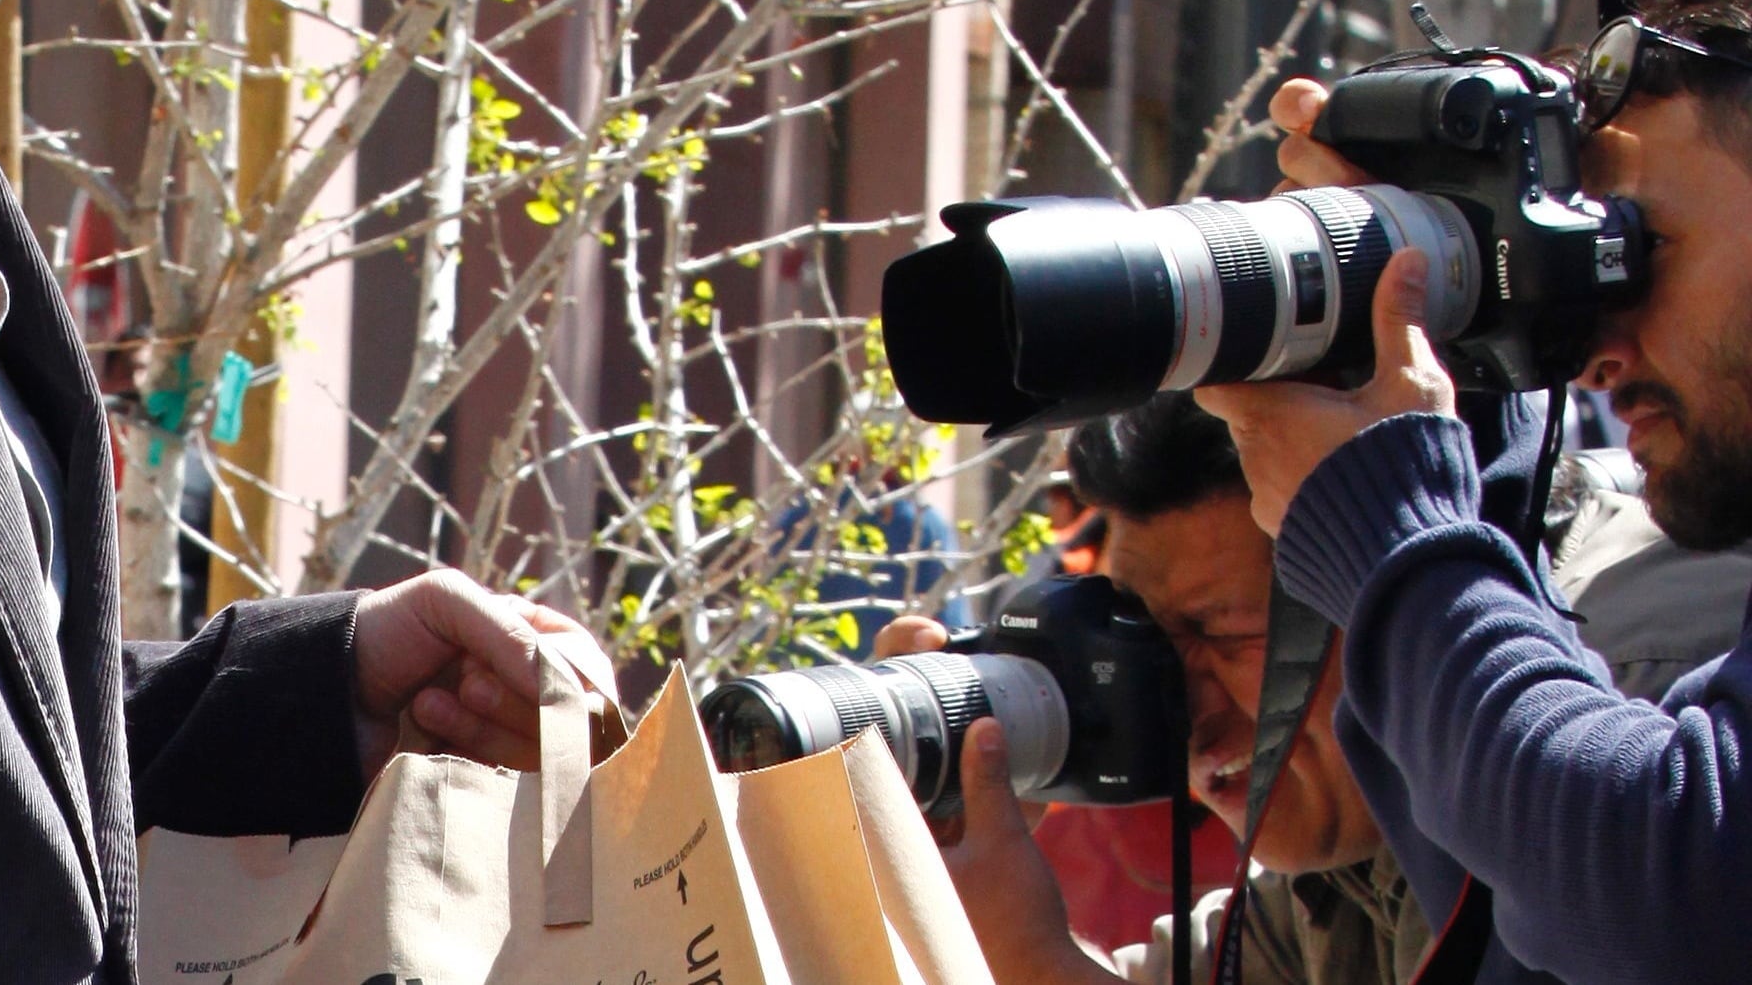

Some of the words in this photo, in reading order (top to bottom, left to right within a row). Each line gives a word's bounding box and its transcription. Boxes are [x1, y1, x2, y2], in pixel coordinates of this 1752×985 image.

[1497, 239, 1511, 299] Canon
[1001, 614, 1038, 629] Canon
[634, 865, 663, 890] PLEASE
[664, 853, 680, 875] HOLD
[175, 961, 212, 974] PLEASE
[212, 959, 237, 972] HOLD
